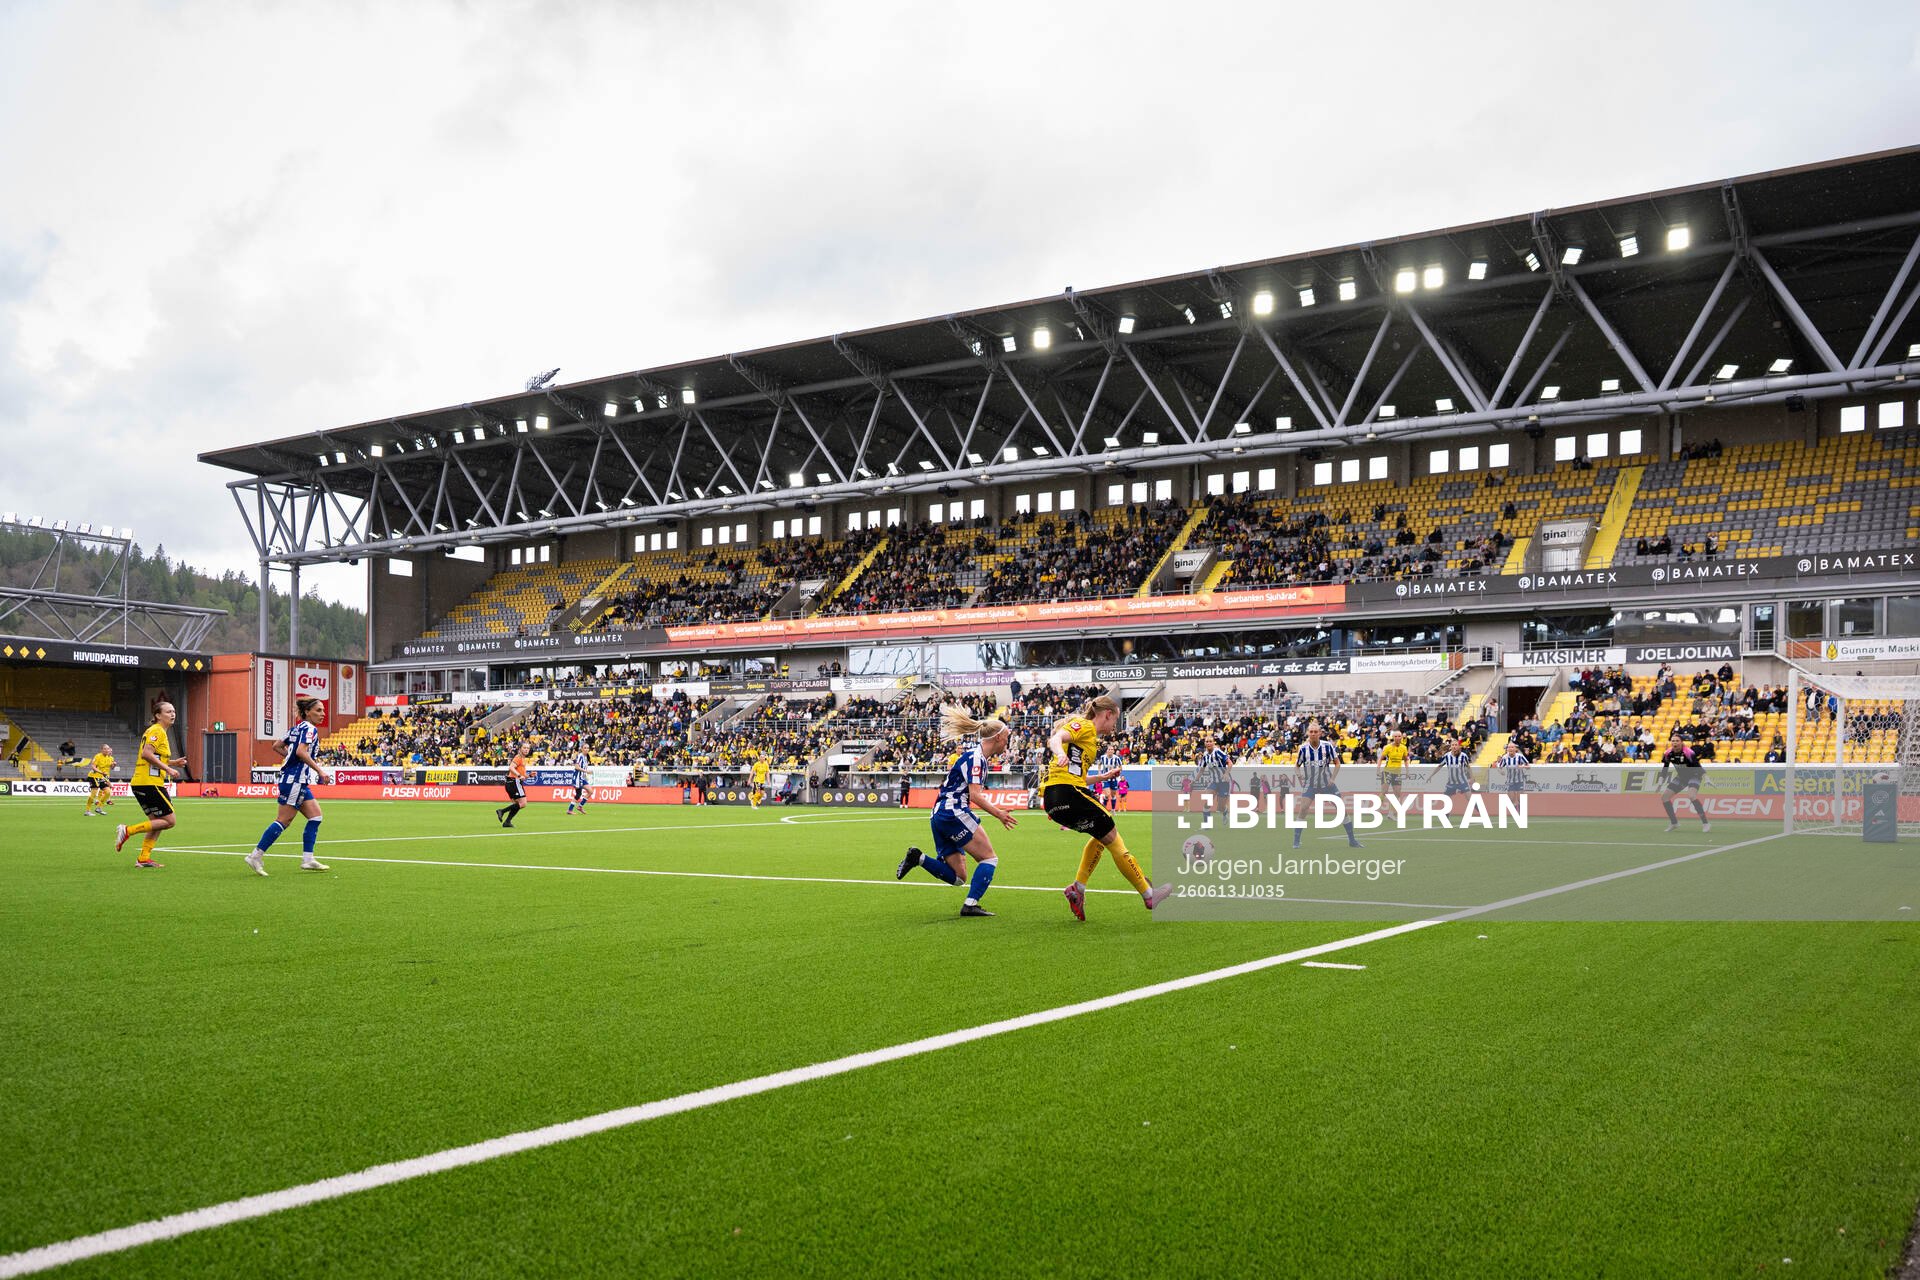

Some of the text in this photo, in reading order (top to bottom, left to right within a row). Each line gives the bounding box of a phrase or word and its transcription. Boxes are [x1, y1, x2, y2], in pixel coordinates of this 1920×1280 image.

[1820, 553, 1914, 570] BAMATEX
[1672, 563, 1759, 579] BAMATEX
[1538, 572, 1617, 587] BAMATEX
[1413, 580, 1486, 594] BAMATEX
[523, 638, 560, 647] BAMATEX
[583, 634, 622, 644] BAMATEX
[1523, 649, 1606, 665] MAKSIMER
[1636, 645, 1733, 661] JOELJOLINA
[1841, 646, 1885, 655] Gunnars
[73, 651, 139, 665] HUVUDPARTNERS
[1173, 664, 1246, 677] Seniorarbeten
[1262, 661, 1281, 674] stc
[1284, 660, 1303, 673] stc
[1305, 660, 1324, 672] stc
[1328, 659, 1348, 671] stc
[1100, 669, 1127, 678] Bloms
[1128, 668, 1142, 677] AB
[13, 784, 47, 794] LKQ
[237, 786, 269, 796] PULSEN
[383, 787, 451, 798] PULSEN GROUP
